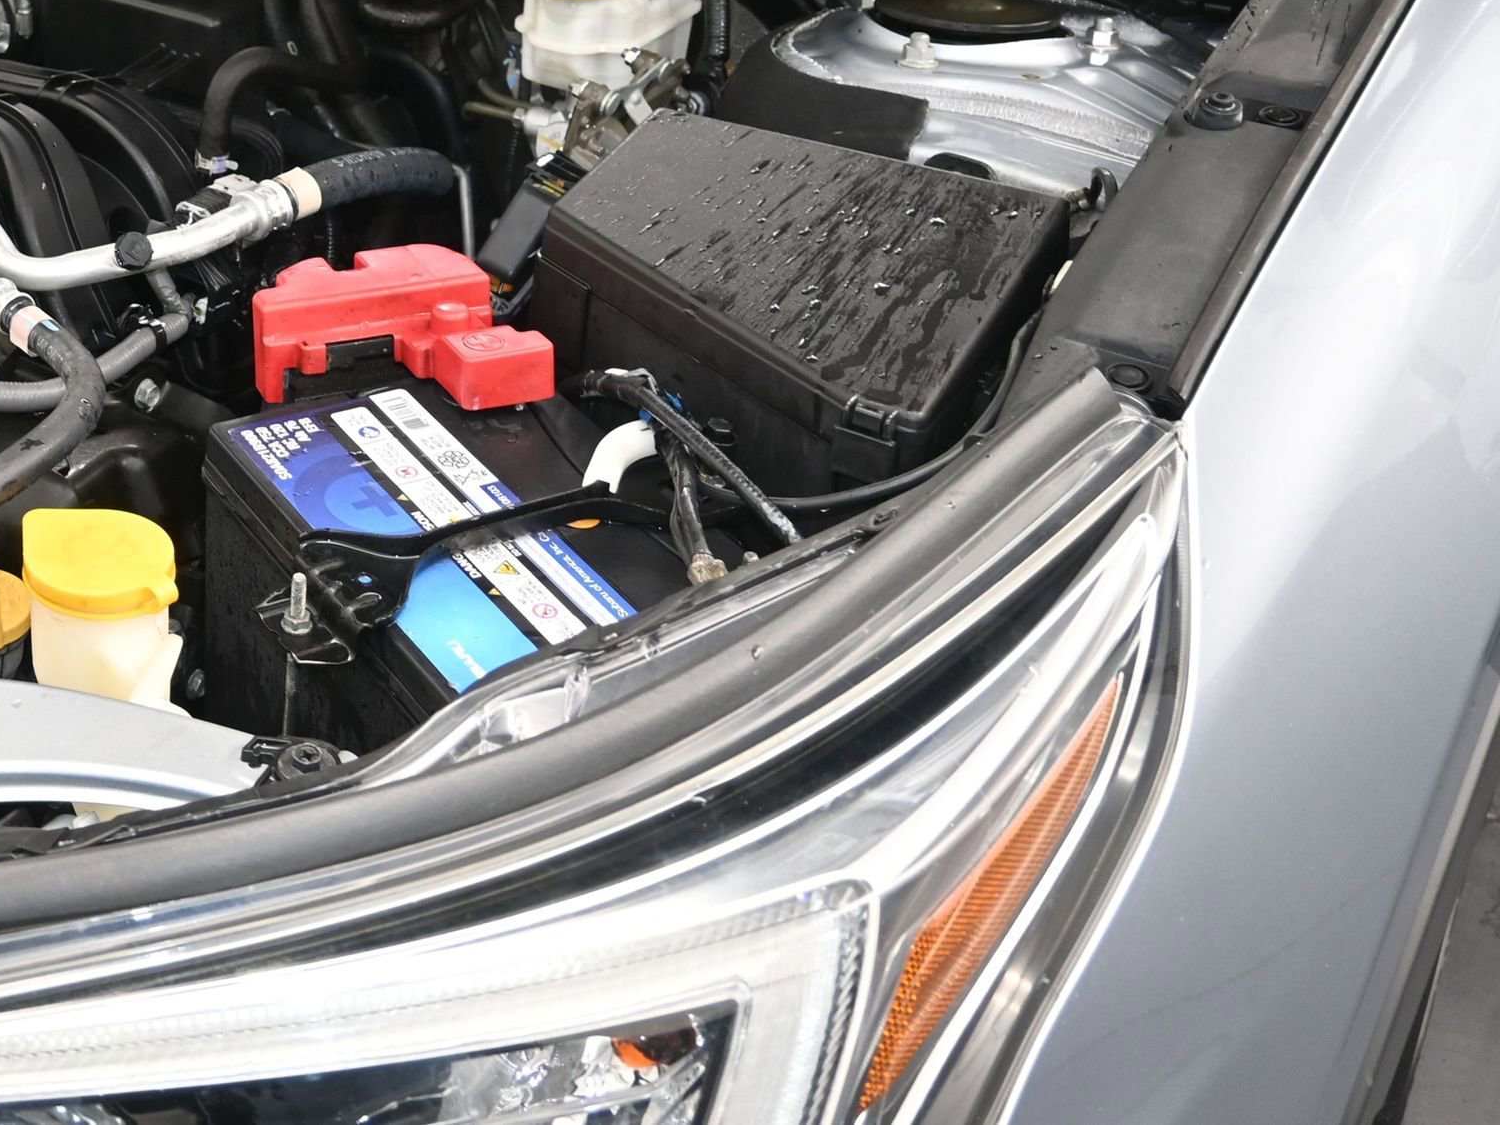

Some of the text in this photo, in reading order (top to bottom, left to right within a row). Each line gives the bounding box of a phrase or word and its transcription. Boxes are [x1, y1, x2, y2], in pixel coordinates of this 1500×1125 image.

[410, 511, 482, 579] DANG SON
[538, 530, 550, 543] Ca
[549, 541, 564, 555] Inc.
[562, 554, 595, 583] America,
[588, 583, 603, 593] of
[600, 590, 629, 617] Subaru
